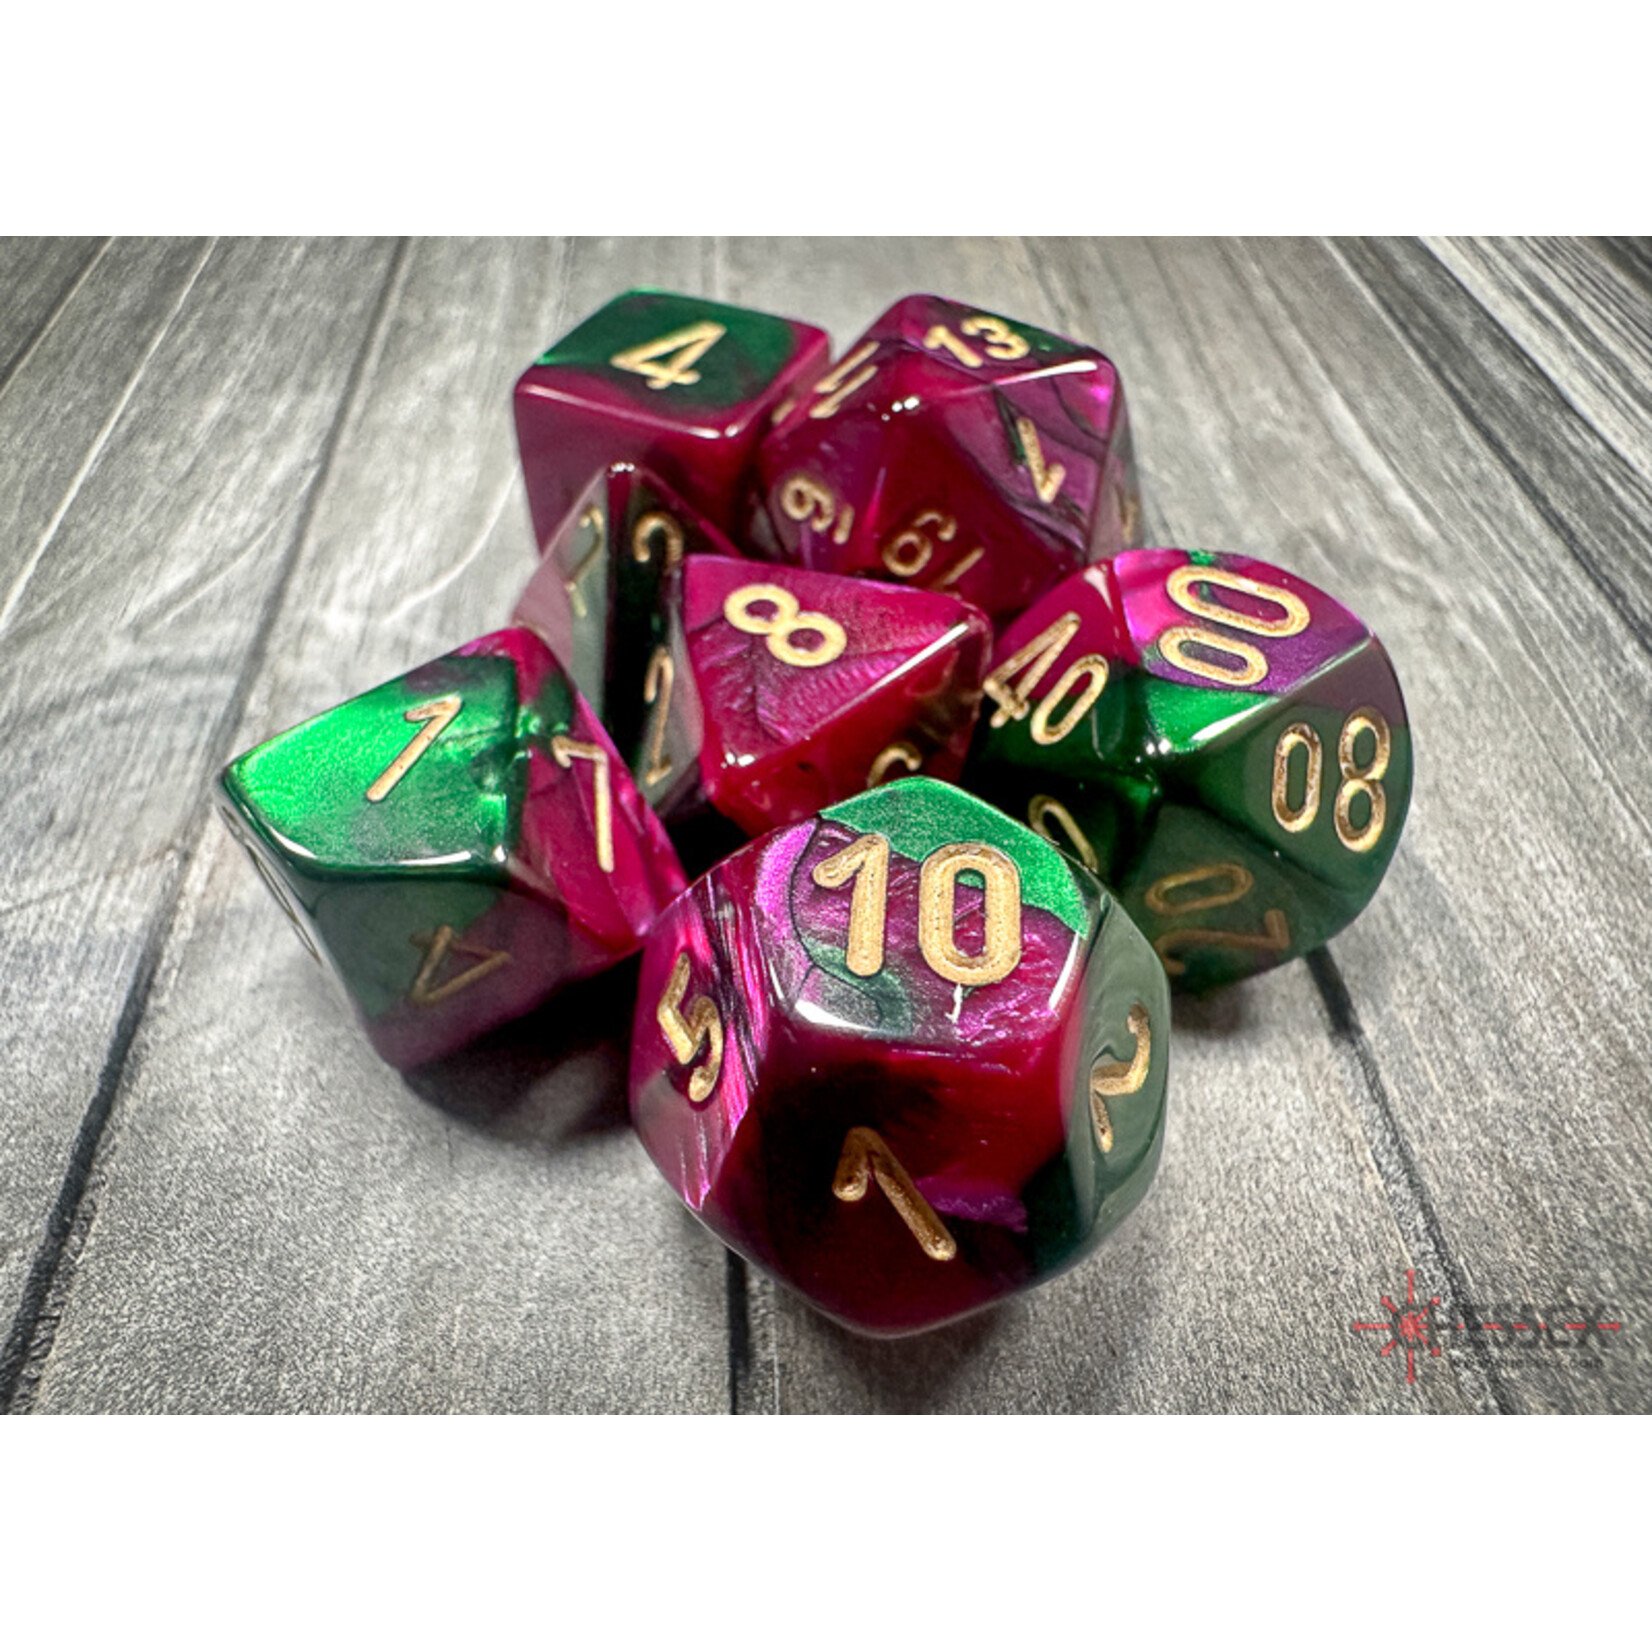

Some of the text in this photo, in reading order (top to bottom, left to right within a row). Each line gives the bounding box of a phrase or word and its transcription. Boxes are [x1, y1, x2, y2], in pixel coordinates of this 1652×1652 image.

[611, 321, 726, 389] 4
[924, 317, 1029, 367] 13
[724, 583, 848, 667] 8
[976, 612, 1109, 745] 40
[1158, 565, 1311, 687] 00
[367, 692, 463, 802] 1
[552, 735, 614, 873] 7
[1272, 707, 1391, 853] 80
[410, 926, 511, 1002] 4
[812, 833, 1022, 986] 10
[657, 952, 724, 1102] 5
[832, 1126, 957, 1261] 1
